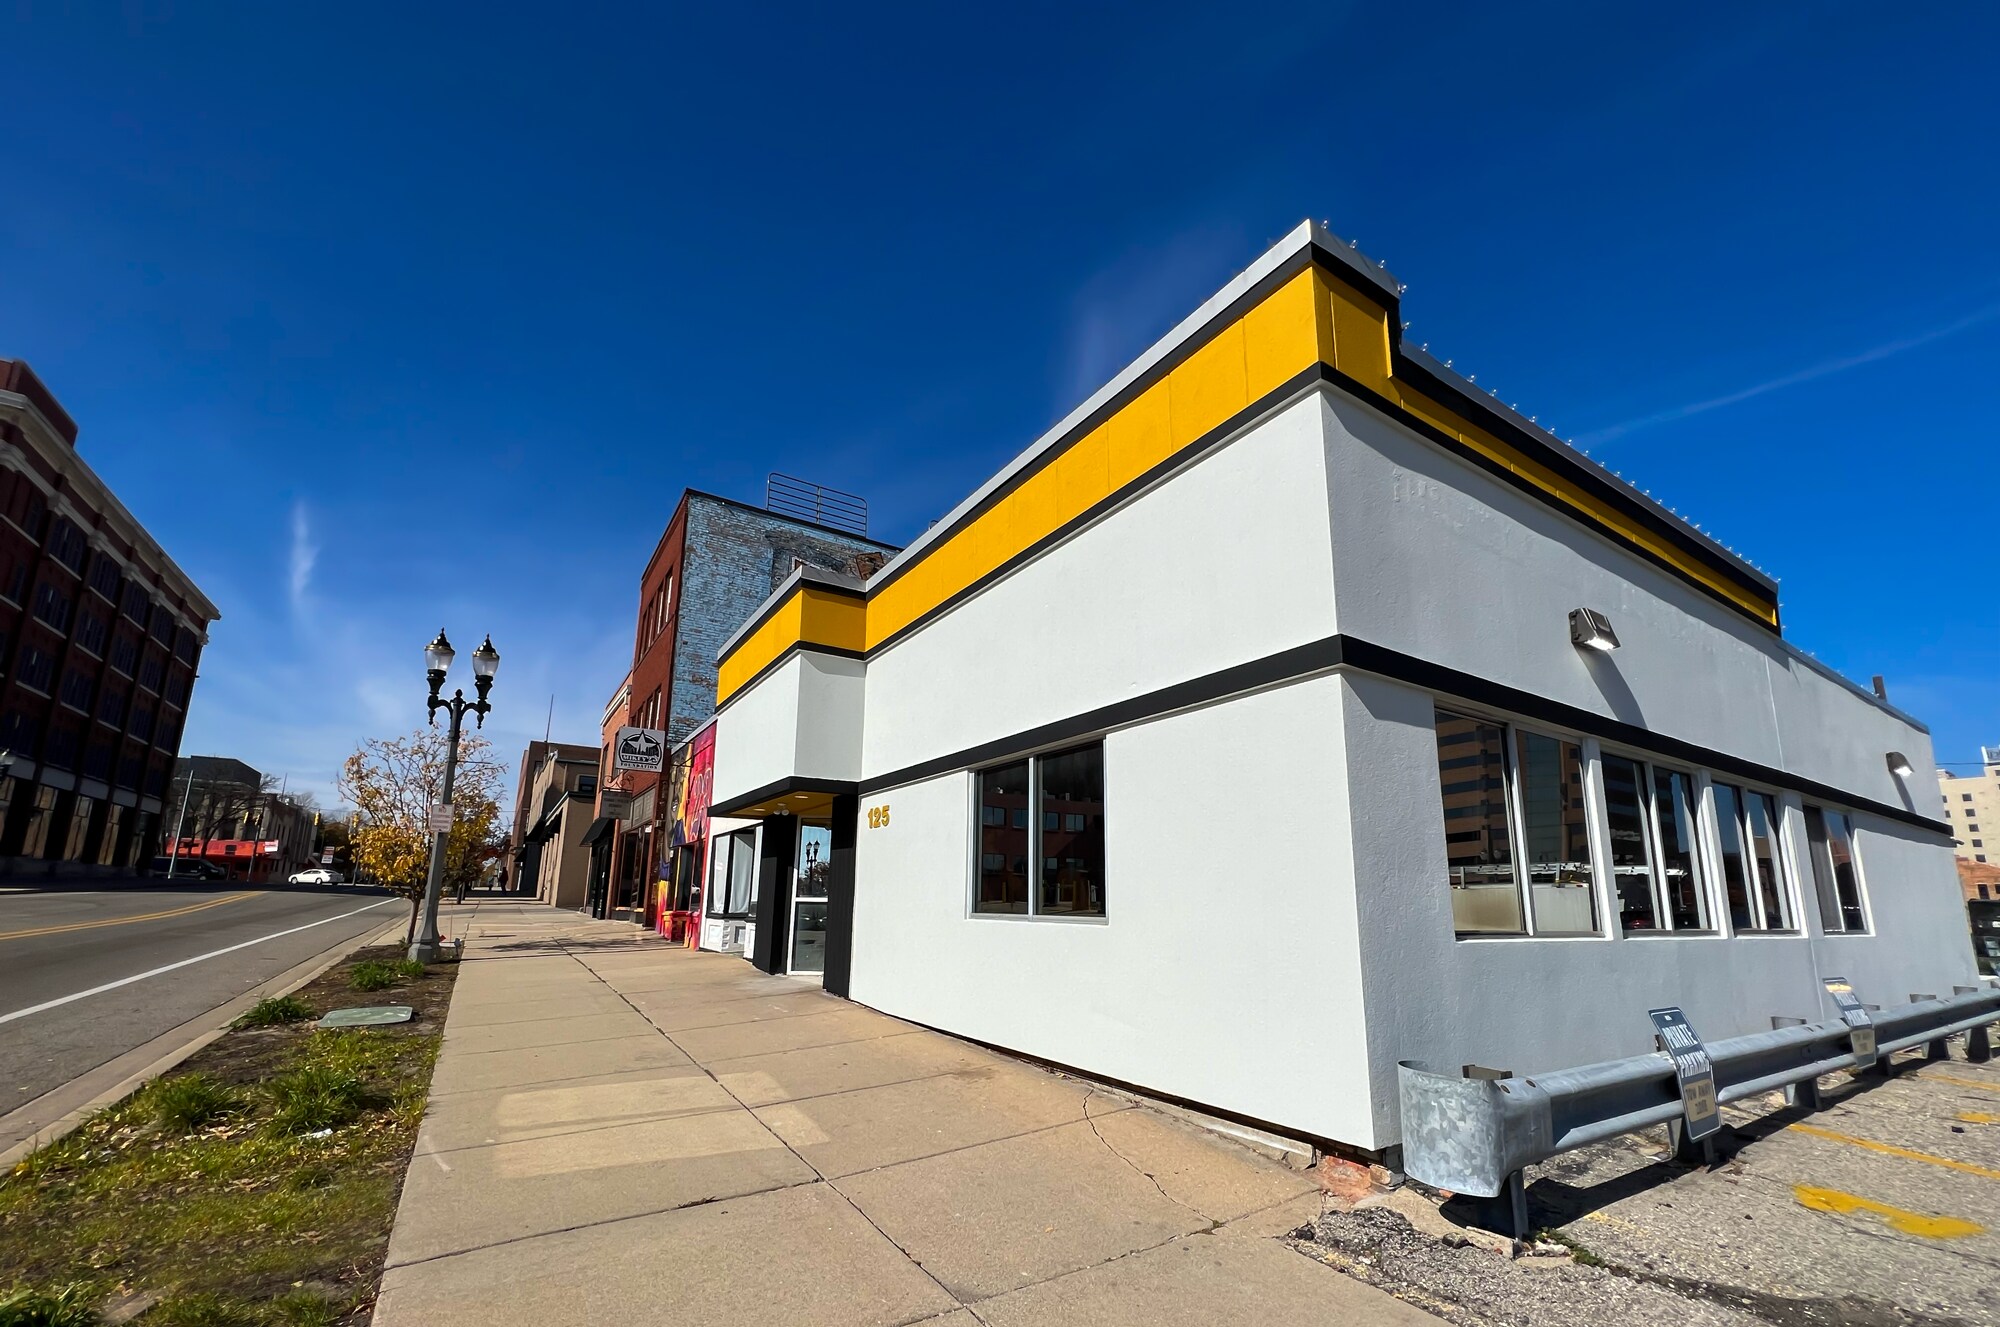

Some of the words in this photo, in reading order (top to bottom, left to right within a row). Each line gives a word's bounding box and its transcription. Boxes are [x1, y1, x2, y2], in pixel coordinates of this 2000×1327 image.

[867, 804, 890, 829] 125
[1662, 1024, 1698, 1049] PRIVATE
[1676, 1050, 1710, 1078] PARKING
